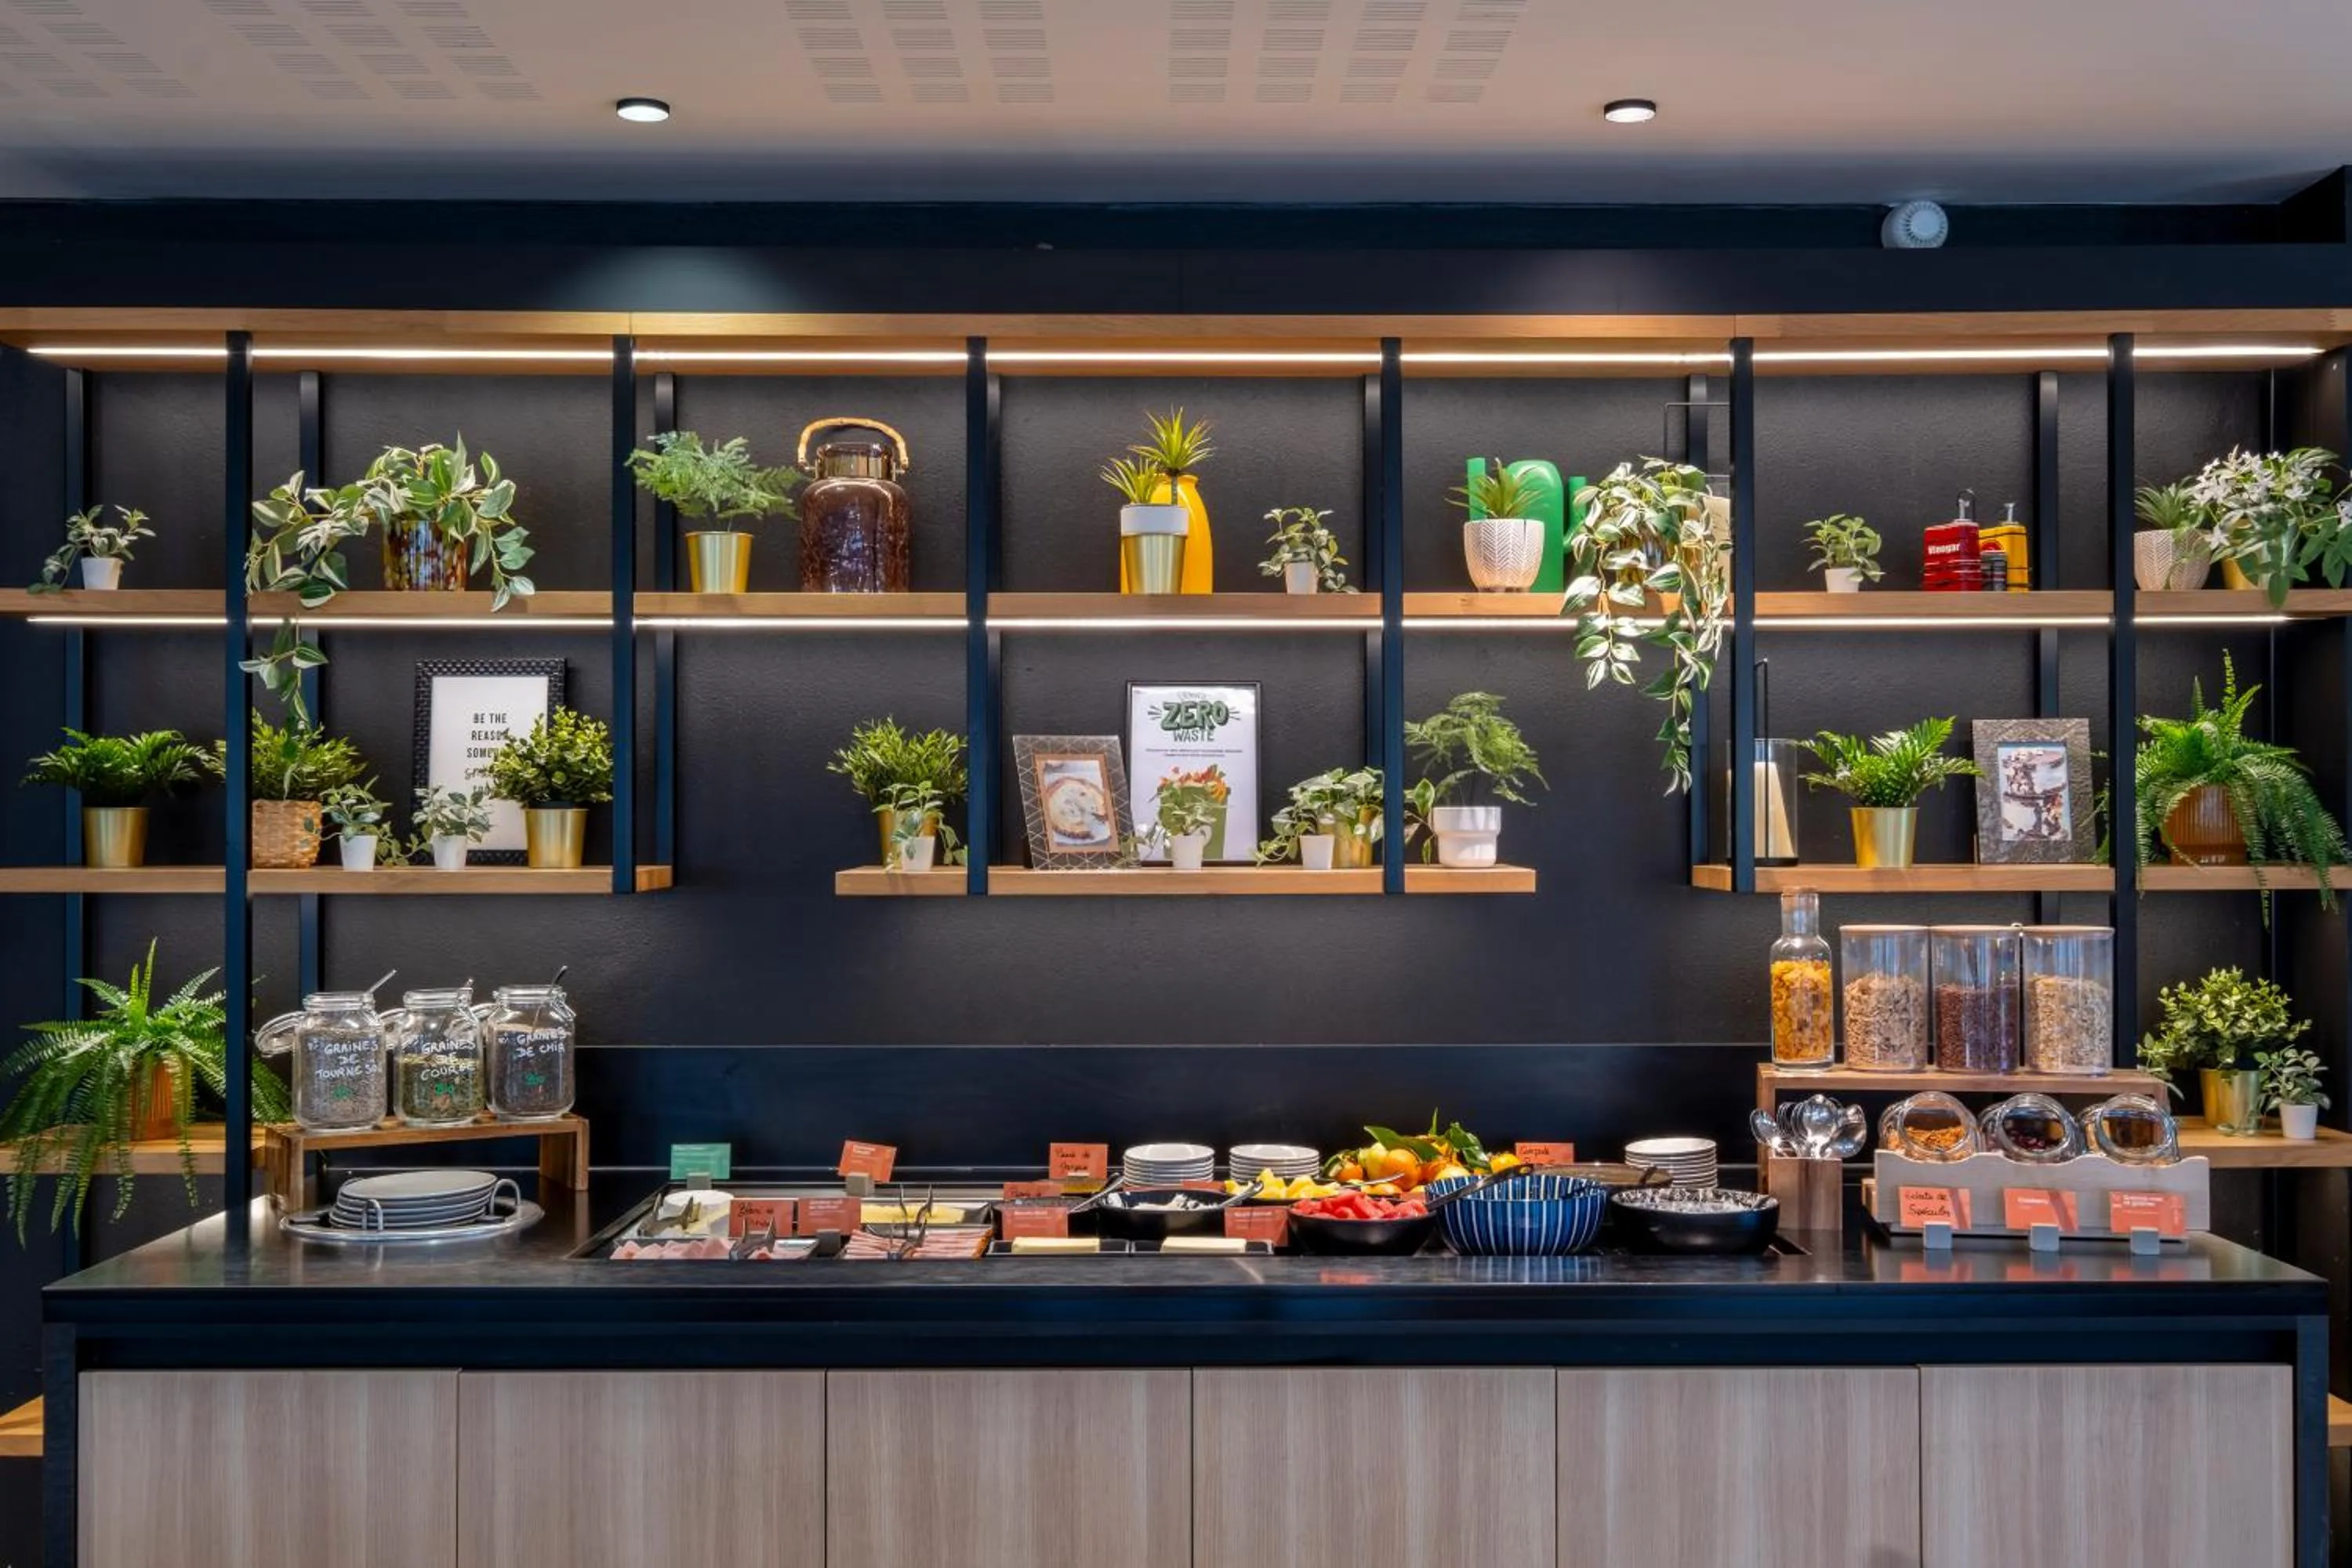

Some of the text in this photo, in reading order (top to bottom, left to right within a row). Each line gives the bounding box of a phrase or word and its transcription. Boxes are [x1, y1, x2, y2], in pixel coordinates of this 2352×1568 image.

[1928, 543, 1960, 555] Vinegar
[473, 713, 507, 724] BE THE
[1160, 700, 1230, 731] ZERO
[1173, 728, 1215, 742] WASTE
